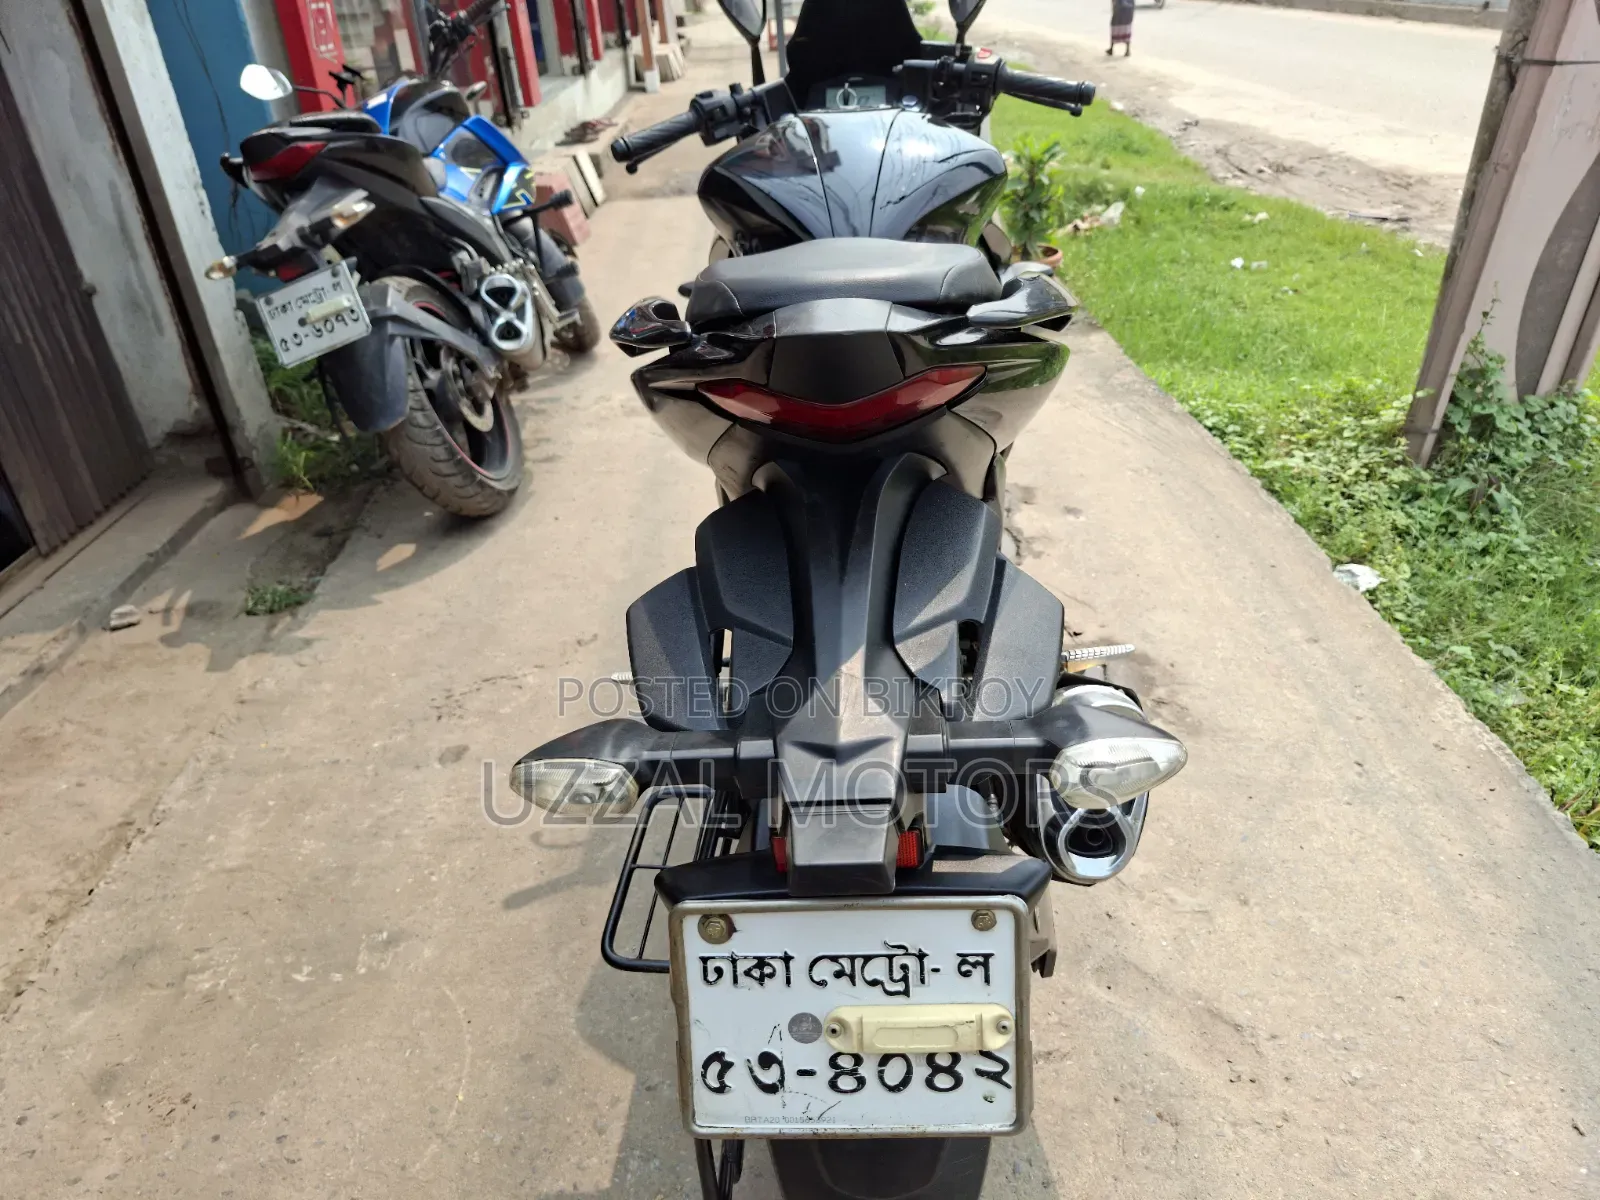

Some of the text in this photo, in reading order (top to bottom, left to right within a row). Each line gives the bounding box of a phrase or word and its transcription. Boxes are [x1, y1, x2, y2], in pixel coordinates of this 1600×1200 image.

[698, 950, 795, 988] ঢাকা
[956, 951, 996, 986] ল
[701, 1049, 1013, 1094] ৫৩-৪০৪২
